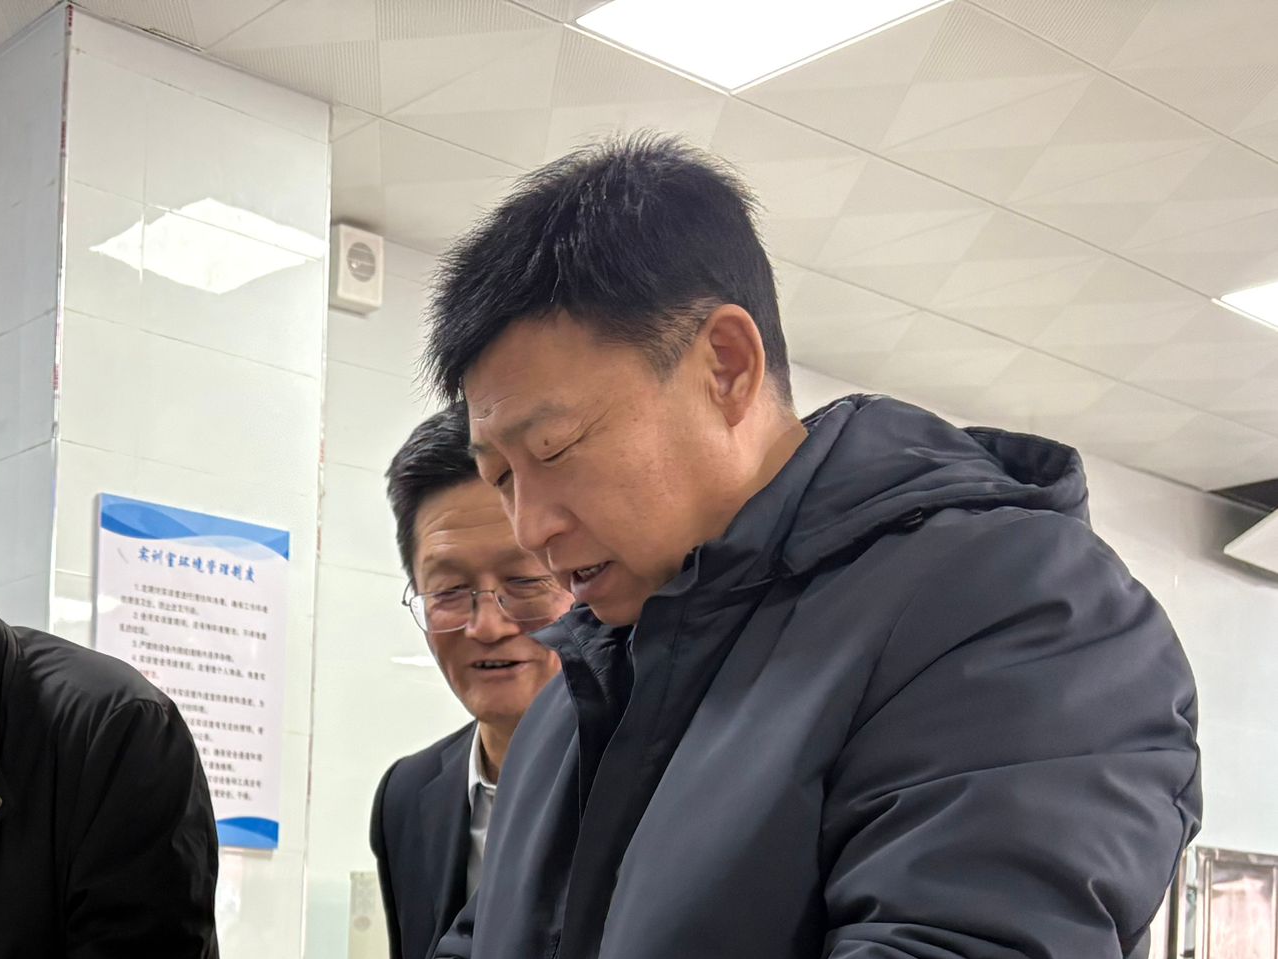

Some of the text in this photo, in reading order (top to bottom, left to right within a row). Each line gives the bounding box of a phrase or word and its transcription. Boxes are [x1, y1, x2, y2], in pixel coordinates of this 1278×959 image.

[138, 546, 255, 583] 实训室环境管理制度
